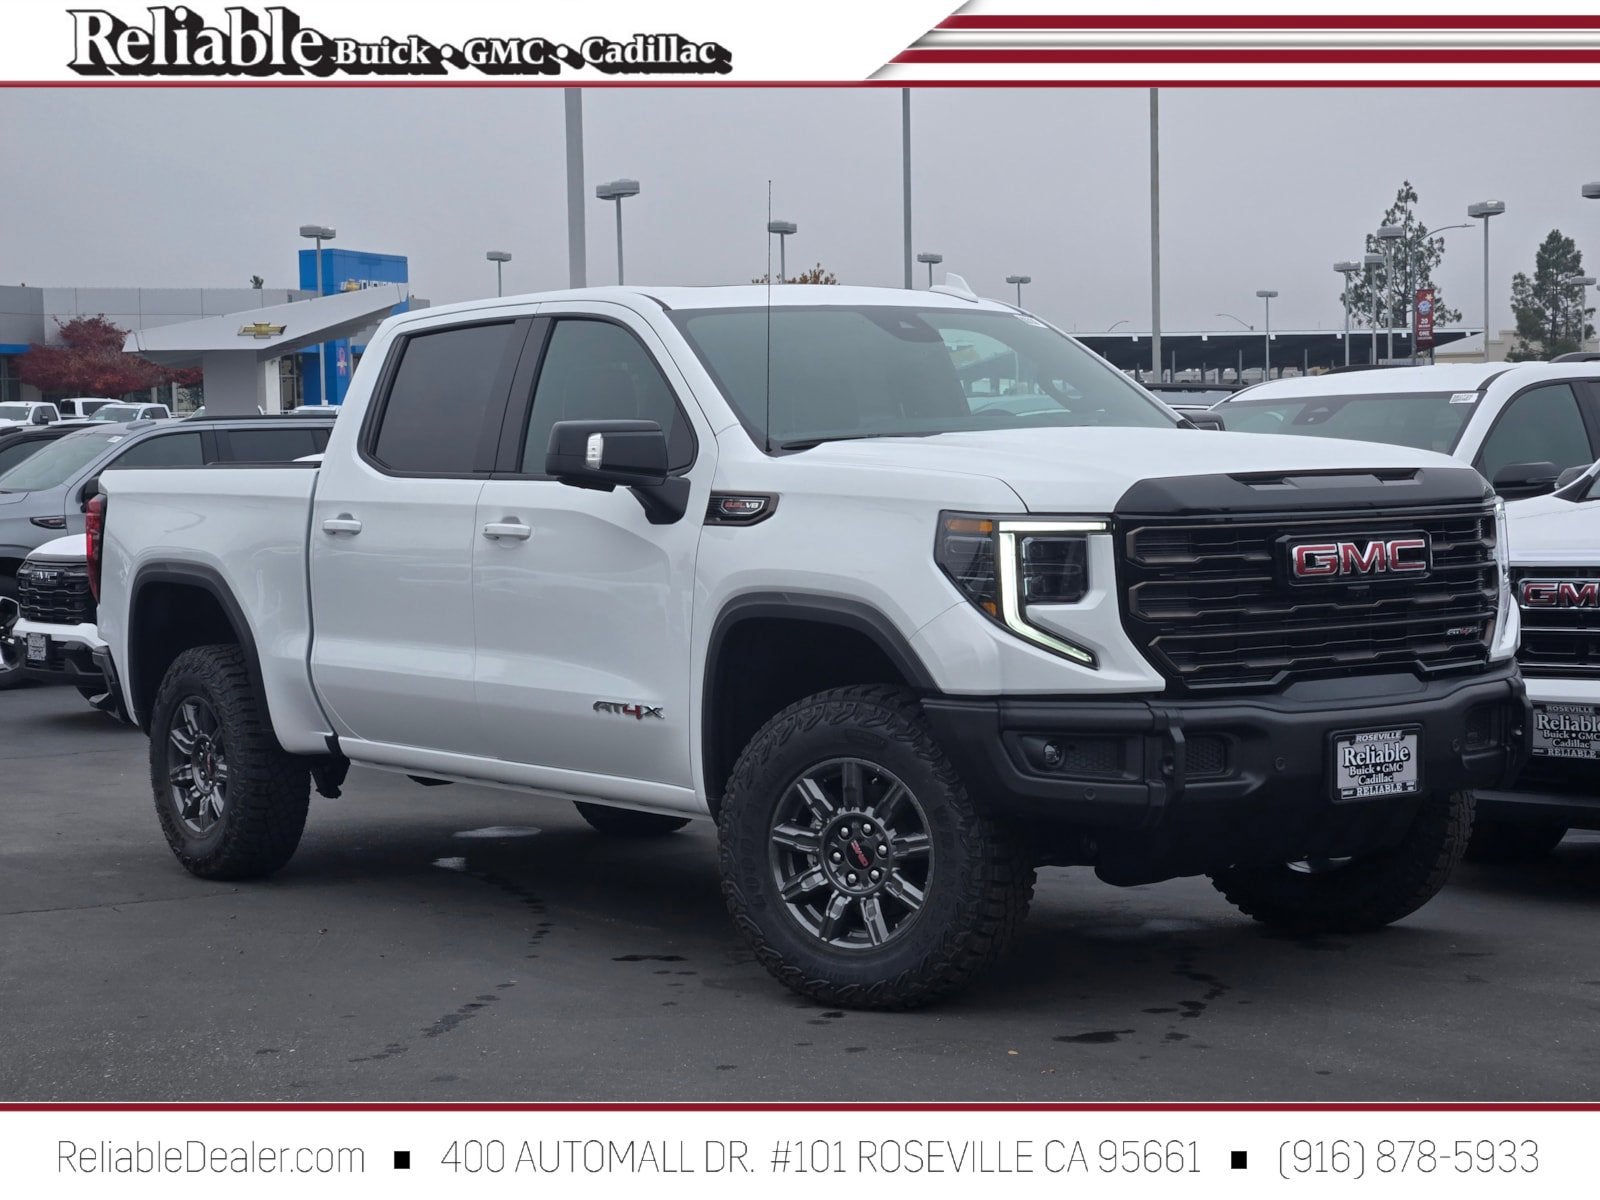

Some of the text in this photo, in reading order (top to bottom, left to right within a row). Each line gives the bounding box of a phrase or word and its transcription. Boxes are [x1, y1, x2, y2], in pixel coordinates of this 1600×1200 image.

[1292, 539, 1426, 577] GMC
[1524, 582, 1600, 606] GM
[592, 700, 665, 720] AT4X
[1546, 704, 1593, 713] ROSEVILLE
[1356, 732, 1401, 743] ROSEVILLE
[1543, 730, 1600, 741] Buick GMC
[1552, 739, 1591, 748] Cadillac
[1343, 742, 1410, 767] Reliable
[1547, 748, 1597, 758] RELIABLE
[1349, 762, 1403, 777] Buick GMC
[1358, 773, 1393, 785] Cadillac
[1356, 782, 1403, 796] RELIABLE
